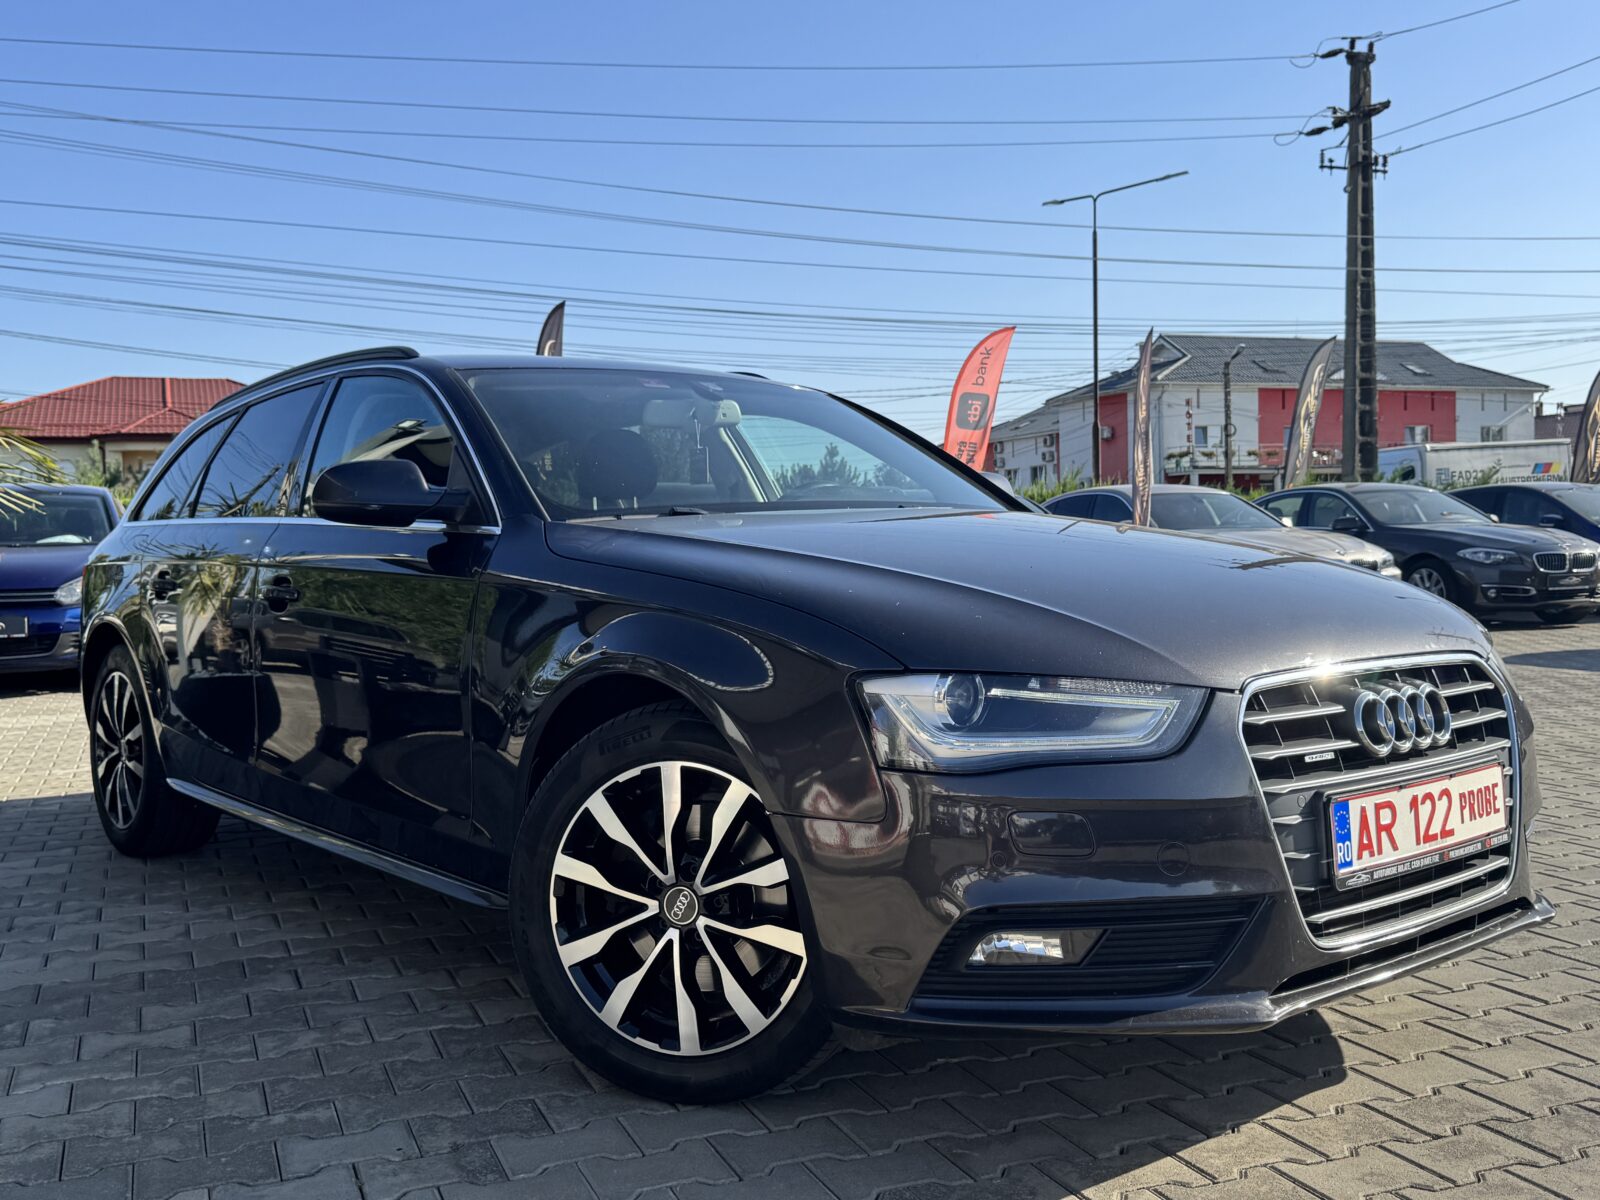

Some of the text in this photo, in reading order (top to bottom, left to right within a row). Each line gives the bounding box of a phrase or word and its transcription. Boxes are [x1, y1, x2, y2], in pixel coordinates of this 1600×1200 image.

[972, 346, 993, 387] bank
[967, 400, 982, 424] tbi
[598, 726, 651, 756] PIRELLI
[1357, 782, 1500, 861] AR 122 PROBE
[1337, 841, 1351, 865] RO
